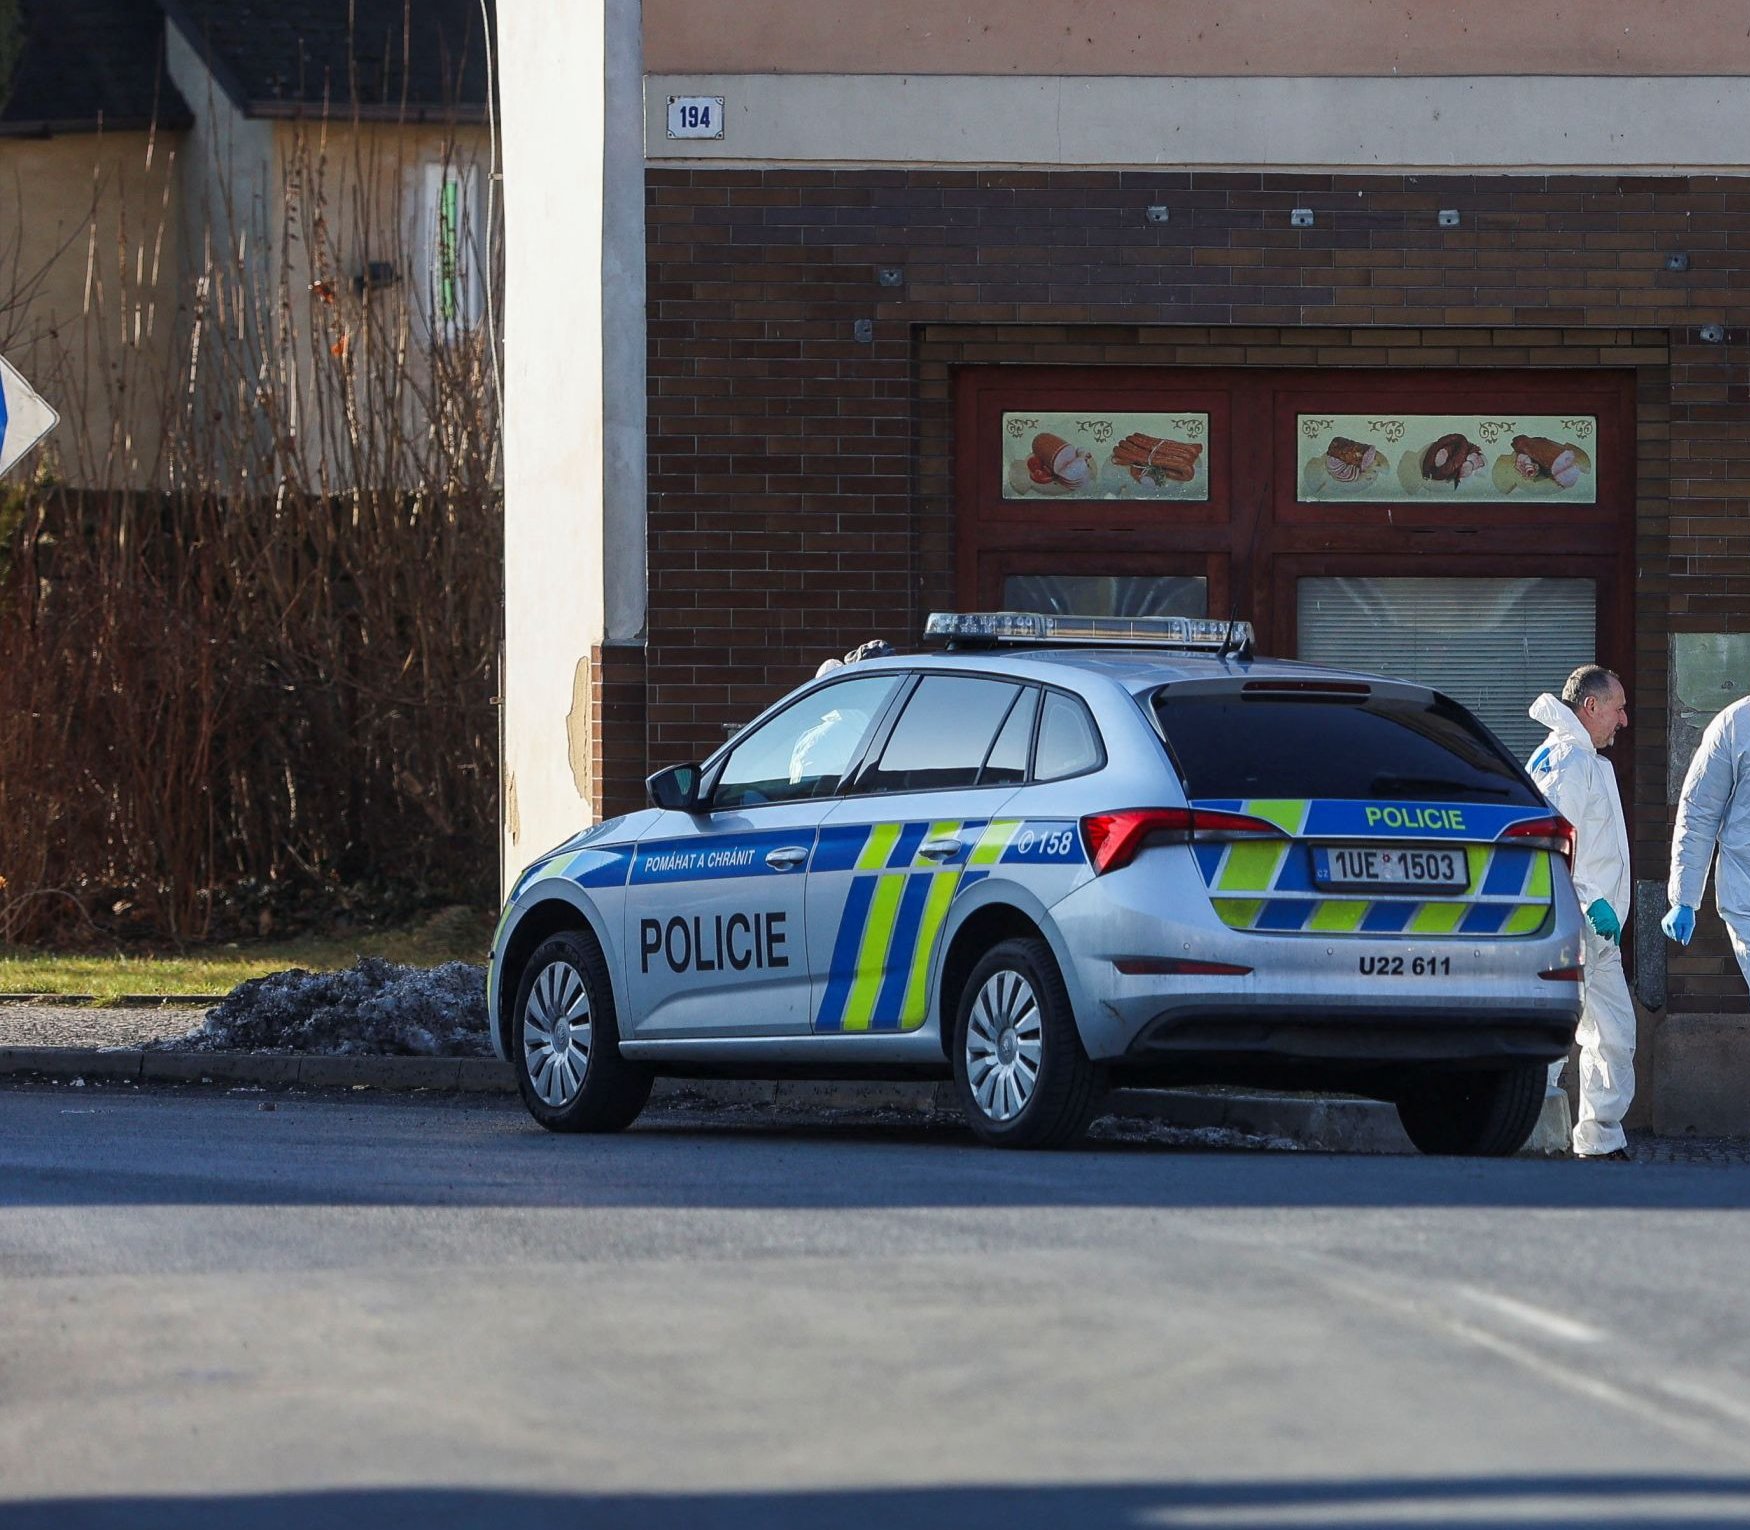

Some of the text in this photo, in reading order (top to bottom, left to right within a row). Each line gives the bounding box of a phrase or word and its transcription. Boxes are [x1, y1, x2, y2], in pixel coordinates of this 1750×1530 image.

[680, 106, 711, 128] 194
[1365, 807, 1466, 830] POLICIE
[1038, 830, 1073, 855] 158
[644, 846, 756, 873] POMÁHAT A CHRÁNIT
[1335, 851, 1456, 881] 1UE 1503
[1316, 869, 1329, 878] CZ
[640, 911, 789, 974] POLICIE
[1359, 956, 1451, 976] U22 611
